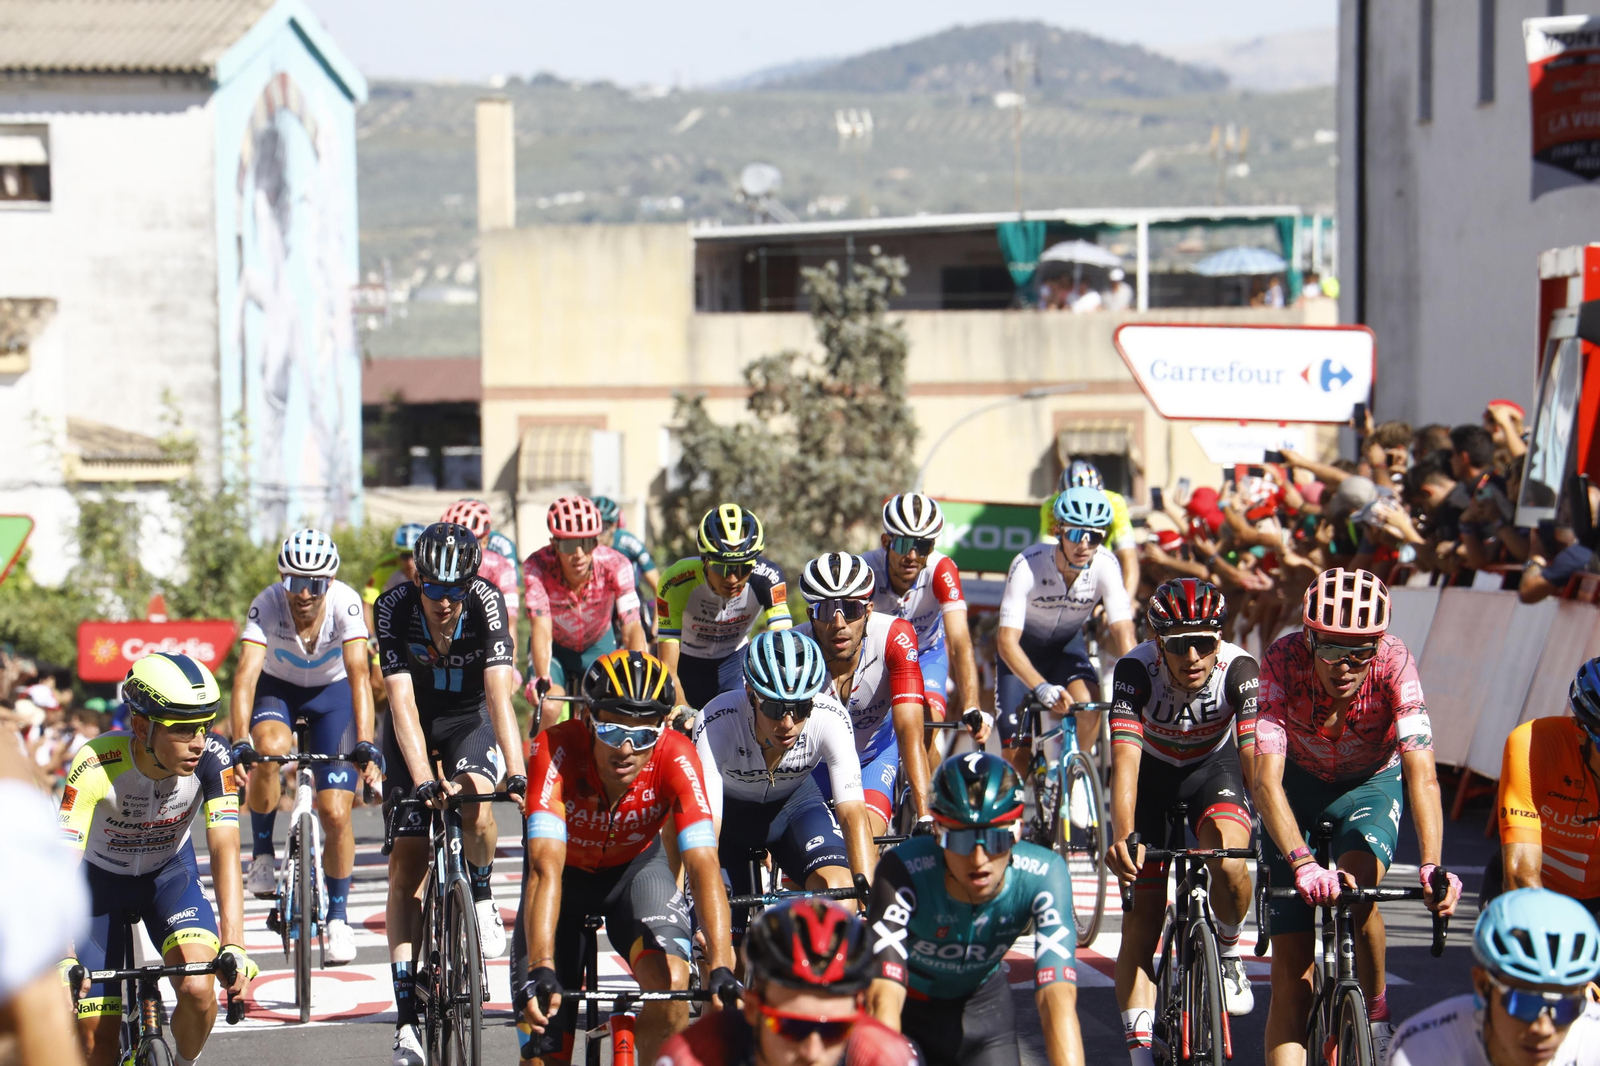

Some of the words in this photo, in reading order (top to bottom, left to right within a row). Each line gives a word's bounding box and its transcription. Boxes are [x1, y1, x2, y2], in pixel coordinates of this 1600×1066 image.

[1150, 359, 1285, 385] Carrefour
[934, 523, 1040, 551] KOD
[751, 562, 780, 584] allonie
[942, 571, 954, 587] FDJ
[468, 579, 502, 631] youfone
[1033, 595, 1095, 604] ASTANA
[378, 586, 407, 639] youfone
[894, 632, 914, 649] FDJ
[131, 678, 172, 707] FORCE
[1115, 681, 1136, 695] FAB
[1238, 677, 1260, 693] FAB
[1151, 700, 1221, 726] UAE
[203, 737, 231, 765] llonie
[540, 745, 566, 809] MERIDA
[726, 765, 813, 777] ASTANA
[674, 754, 711, 815] MERIDA
[1548, 791, 1589, 804] ORBEA
[565, 799, 662, 824] BAHRAIN
[1548, 826, 1595, 840] GRUPO
[904, 854, 936, 875] BORA
[1012, 854, 1050, 877] BORA
[167, 909, 196, 925] TORMANS
[912, 940, 1010, 961] BORA
[585, 991, 618, 1000] Vision
